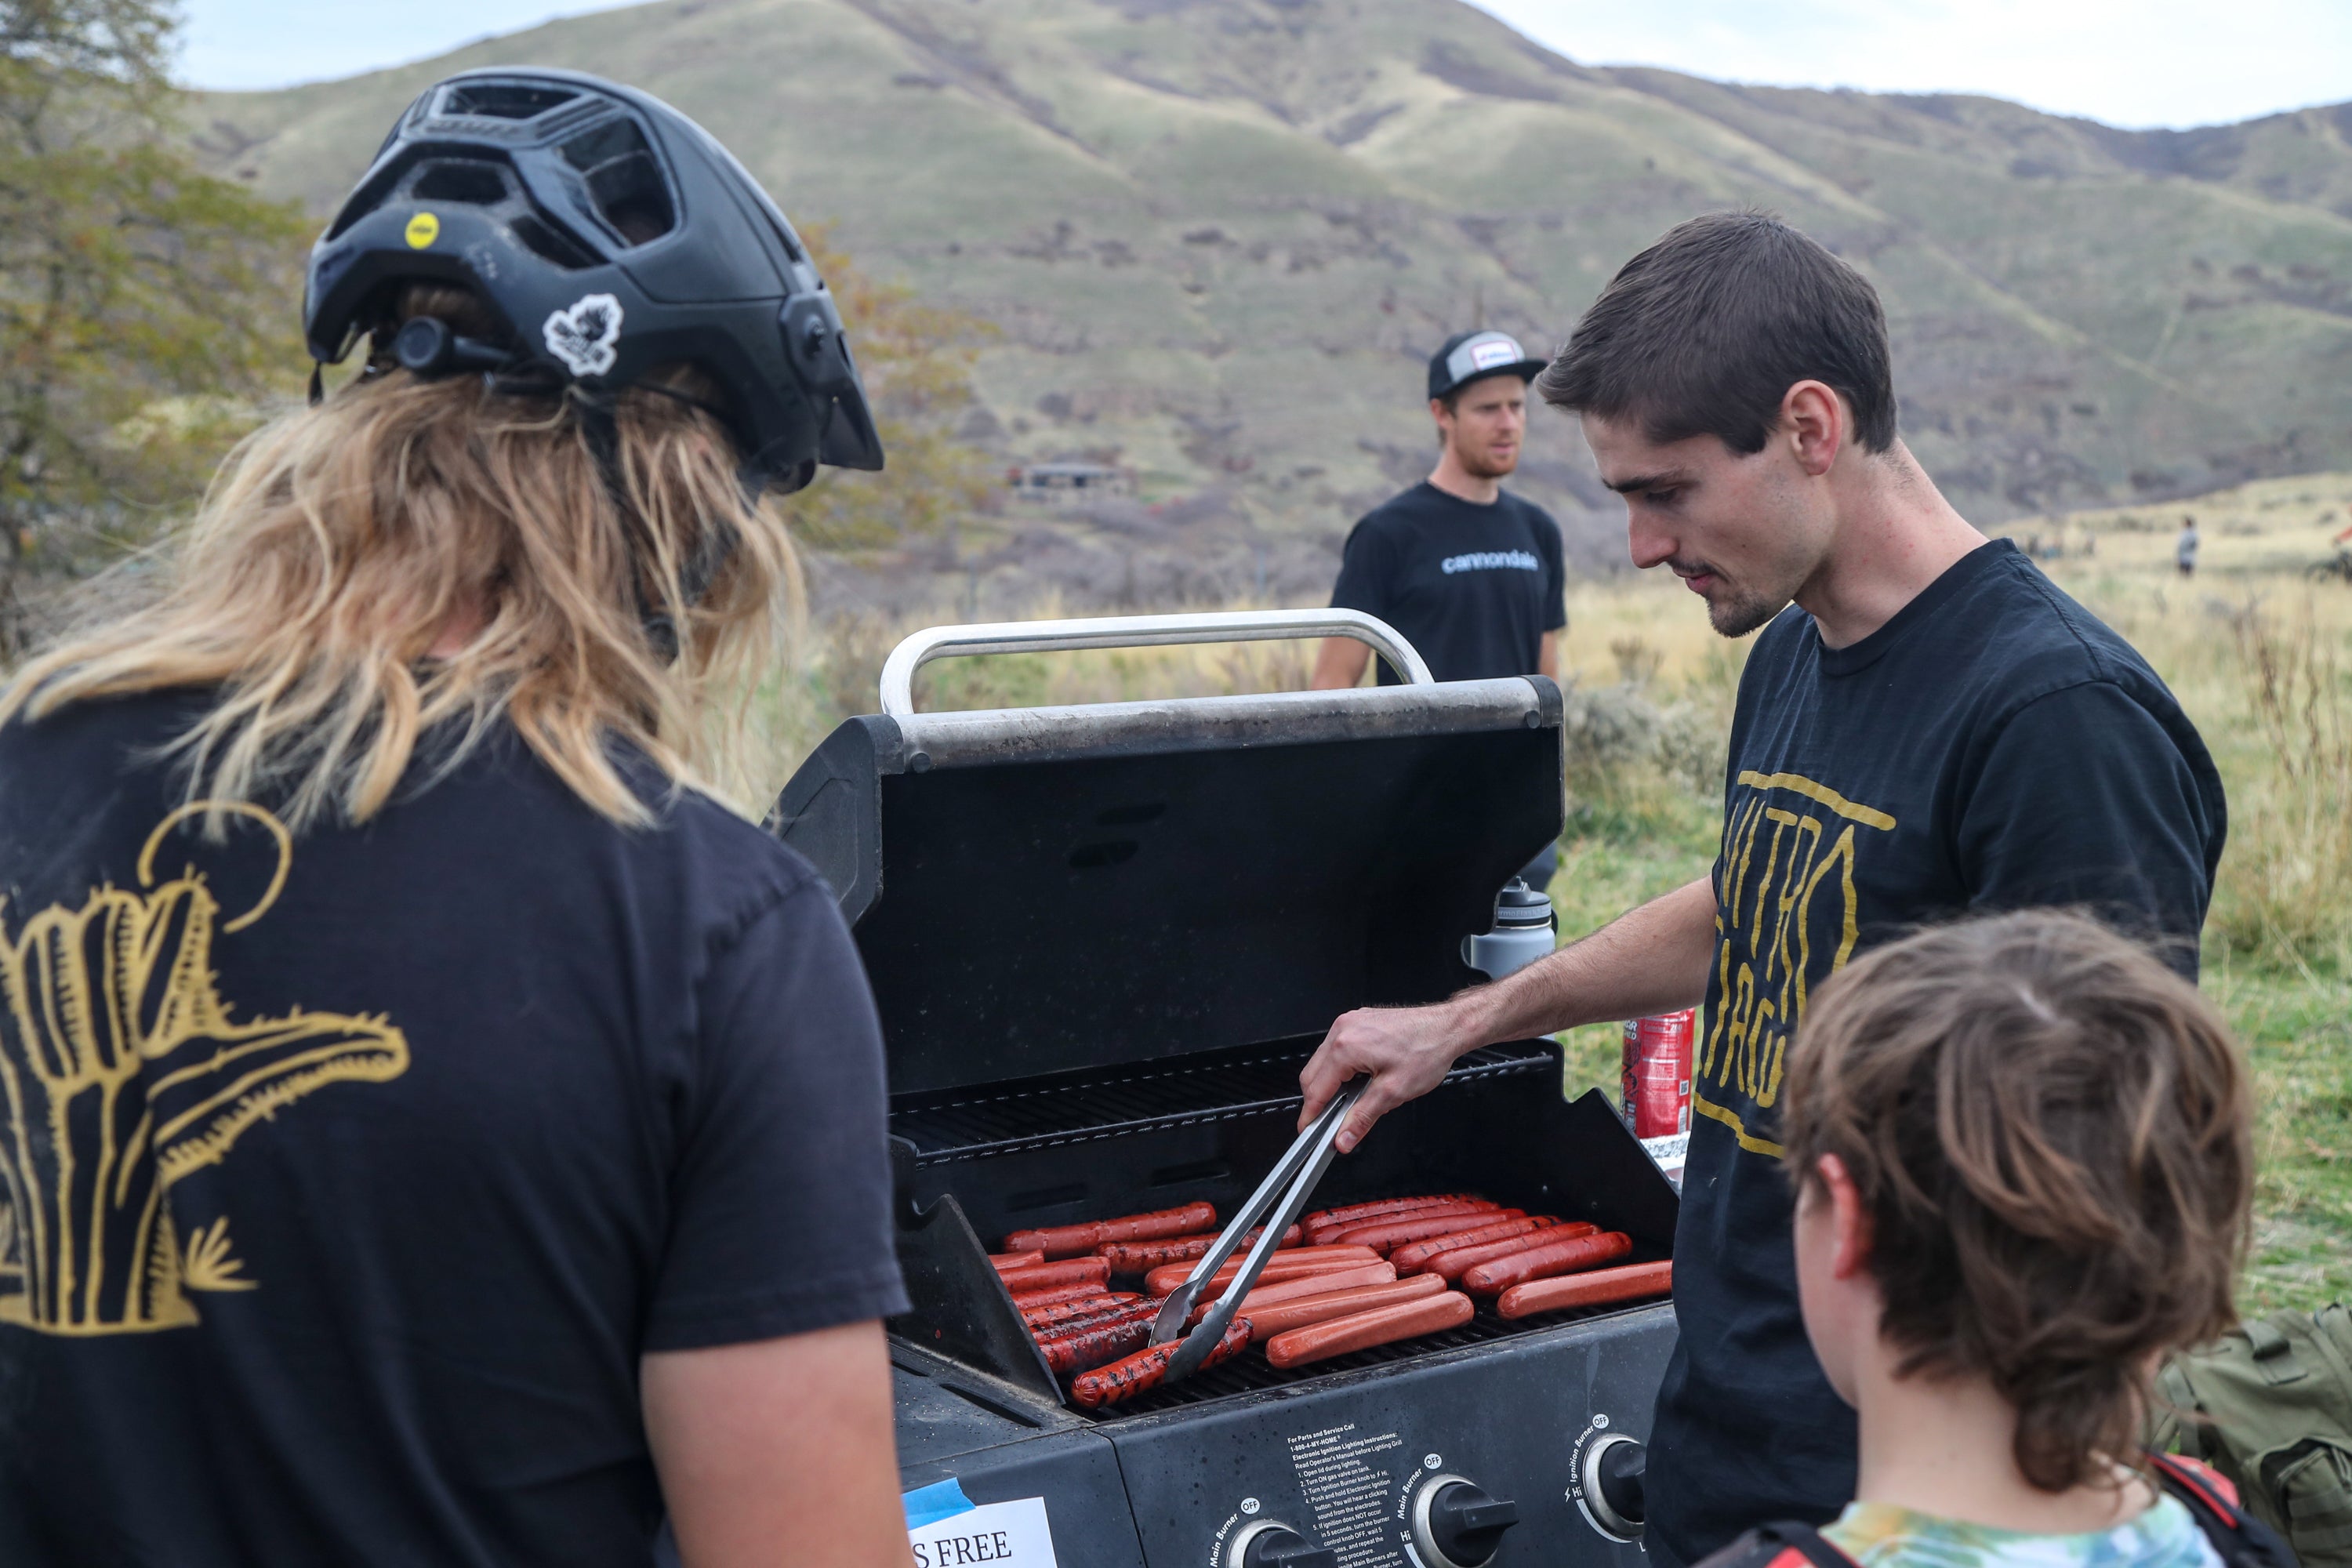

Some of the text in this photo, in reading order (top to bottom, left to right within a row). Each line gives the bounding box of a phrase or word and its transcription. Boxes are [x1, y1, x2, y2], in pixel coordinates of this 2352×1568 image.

[1442, 549, 1538, 575] cannondale
[1594, 1417, 1607, 1426] OFF
[1292, 1432, 1398, 1461] Electronic Ignition Lighting Instructions:
[1310, 1455, 1336, 1467] Operator's
[1372, 1443, 1391, 1452] Lighting
[1570, 1425, 1594, 1482] Ignition Burner
[1425, 1456, 1440, 1466] OFF
[1304, 1470, 1317, 1479] Open
[1341, 1459, 1361, 1468] lighting.
[1321, 1482, 1340, 1491] Ignition
[1347, 1484, 1371, 1494] Electronic
[1372, 1479, 1390, 1488] Ignition
[1572, 1486, 1582, 1497] Hi
[1369, 1489, 1388, 1498] clicking
[1397, 1468, 1422, 1519] Main Burner
[1242, 1500, 1258, 1511] OFF
[1318, 1512, 1333, 1520] sound
[1355, 1500, 1381, 1510] electrodes.
[1323, 1519, 1342, 1529] ignition
[1331, 1526, 1354, 1535] seconds,
[1399, 1530, 1411, 1542] Hi
[1210, 1513, 1239, 1568] Main Burner
[1324, 1537, 1341, 1547] control
[1359, 1539, 1375, 1548] repeat
[935, 1531, 1011, 1567] FREE
[1348, 1549, 1375, 1560] procedure.
[1367, 1555, 1386, 1564] Burners
